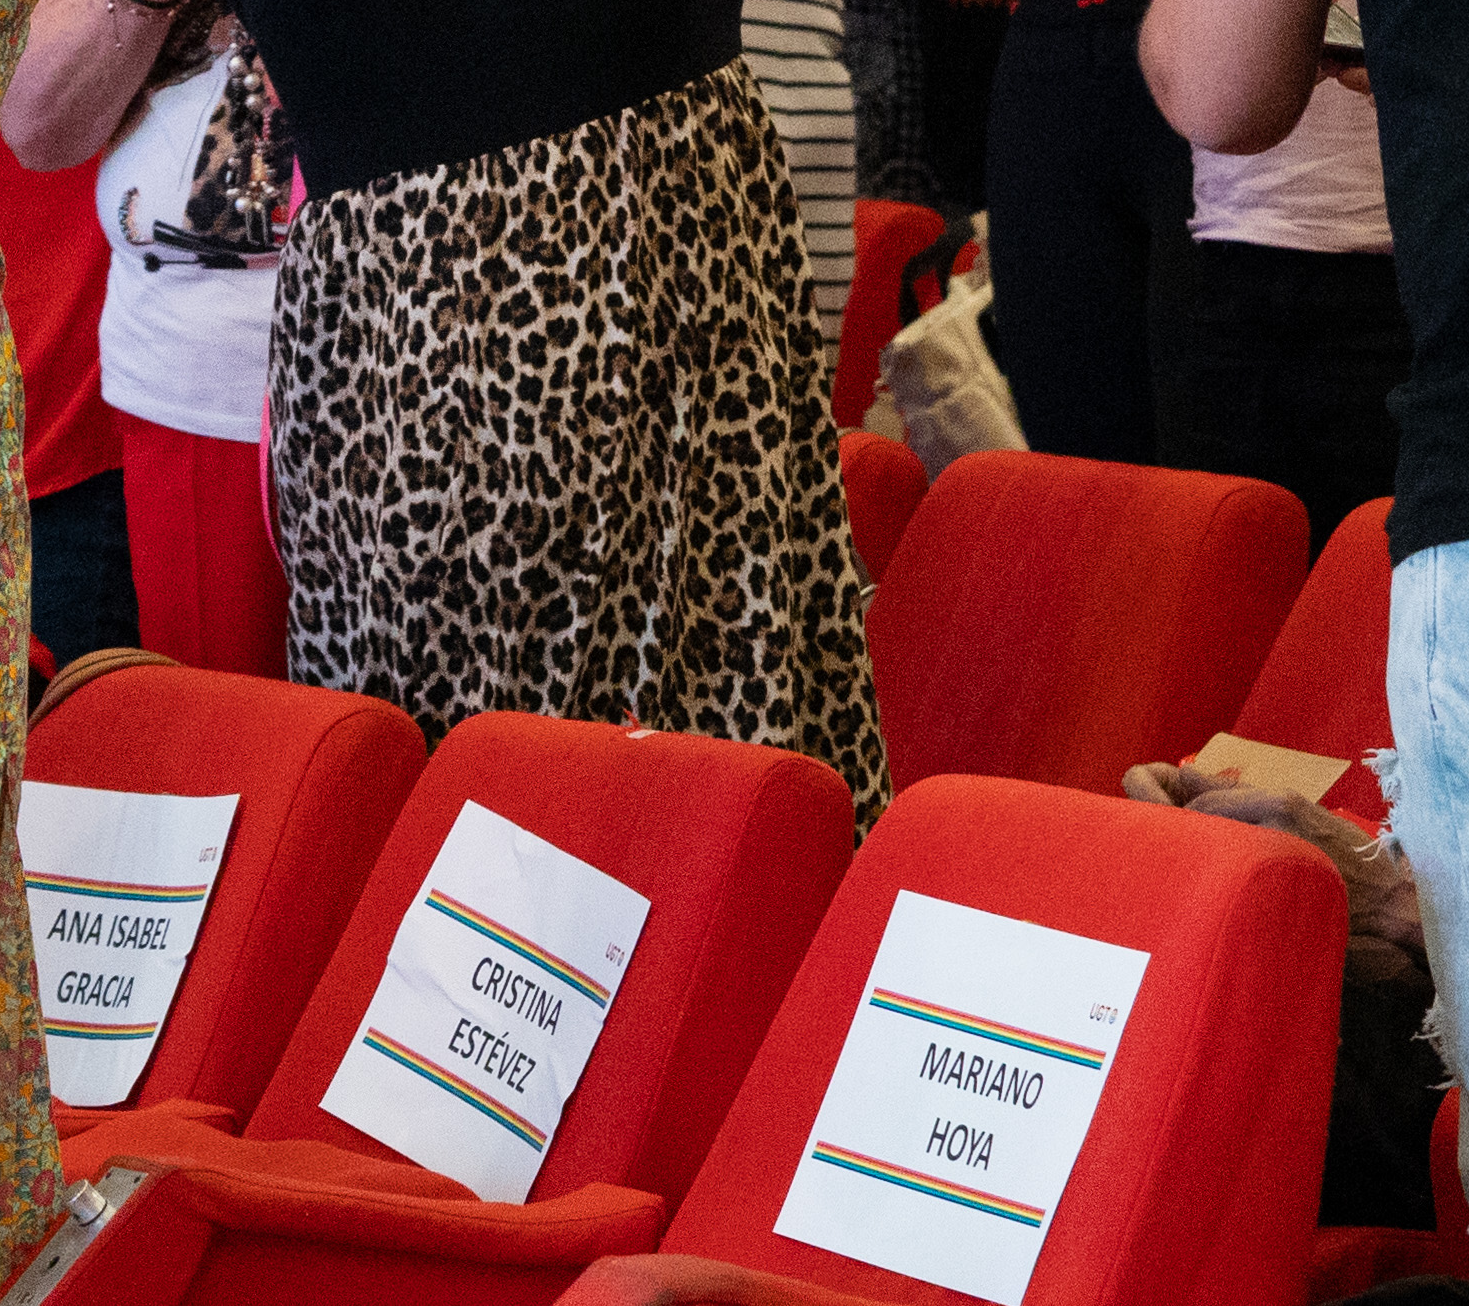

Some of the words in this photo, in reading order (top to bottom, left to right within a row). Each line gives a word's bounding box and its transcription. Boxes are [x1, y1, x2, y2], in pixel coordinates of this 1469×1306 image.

[47, 908, 103, 946] ANA
[106, 915, 171, 951] ISABEL
[57, 970, 135, 1008] GRACIA
[471, 956, 562, 1036] CRISTINA
[448, 1017, 536, 1094] ESTÉVEZ
[919, 1042, 1044, 1110] MARIANO
[926, 1118, 993, 1171] HOYA
